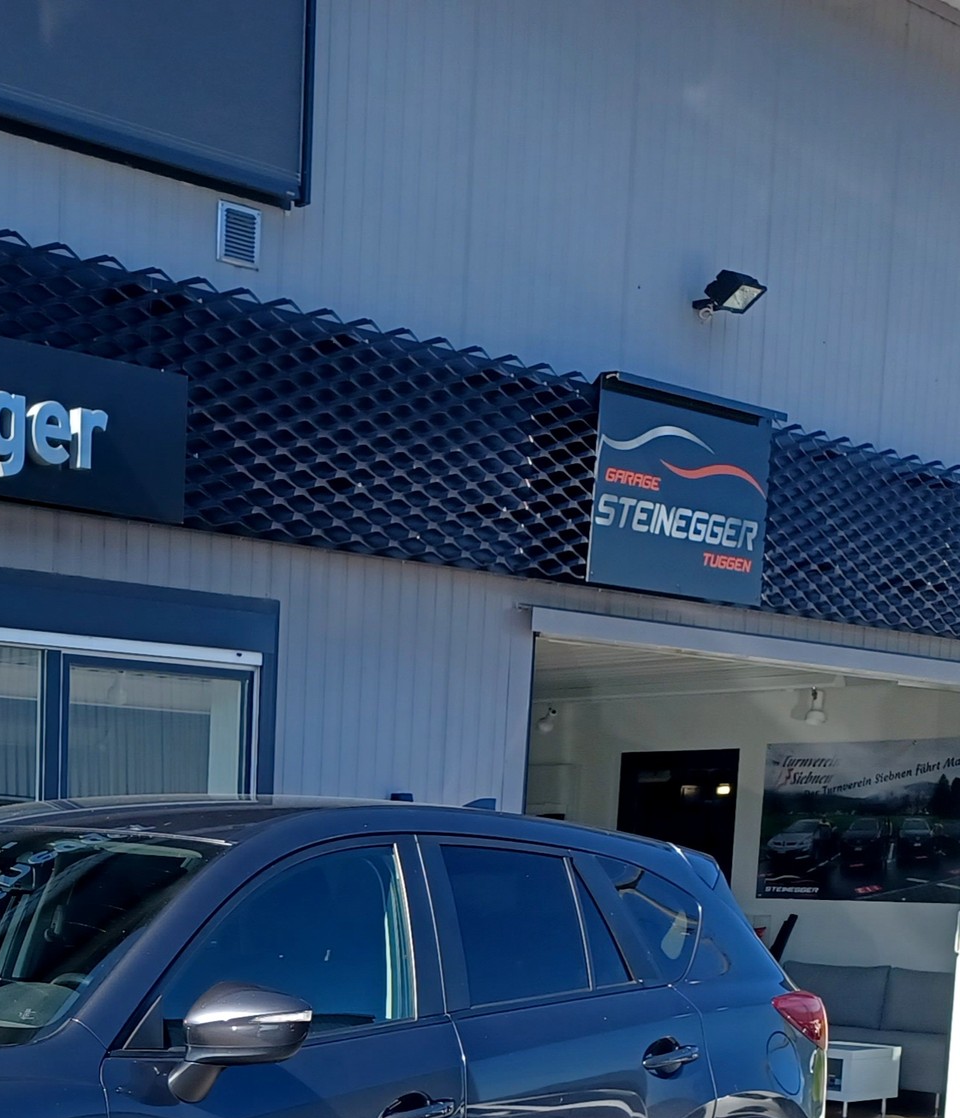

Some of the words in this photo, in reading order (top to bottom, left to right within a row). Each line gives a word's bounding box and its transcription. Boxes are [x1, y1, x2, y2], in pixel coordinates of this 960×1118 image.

[604, 467, 662, 491] GARAGE
[595, 493, 759, 551] STEINEGGER
[703, 552, 753, 573] TUGGEN
[822, 777, 872, 796] Turnverein
[875, 771, 912, 784] Siebnen
